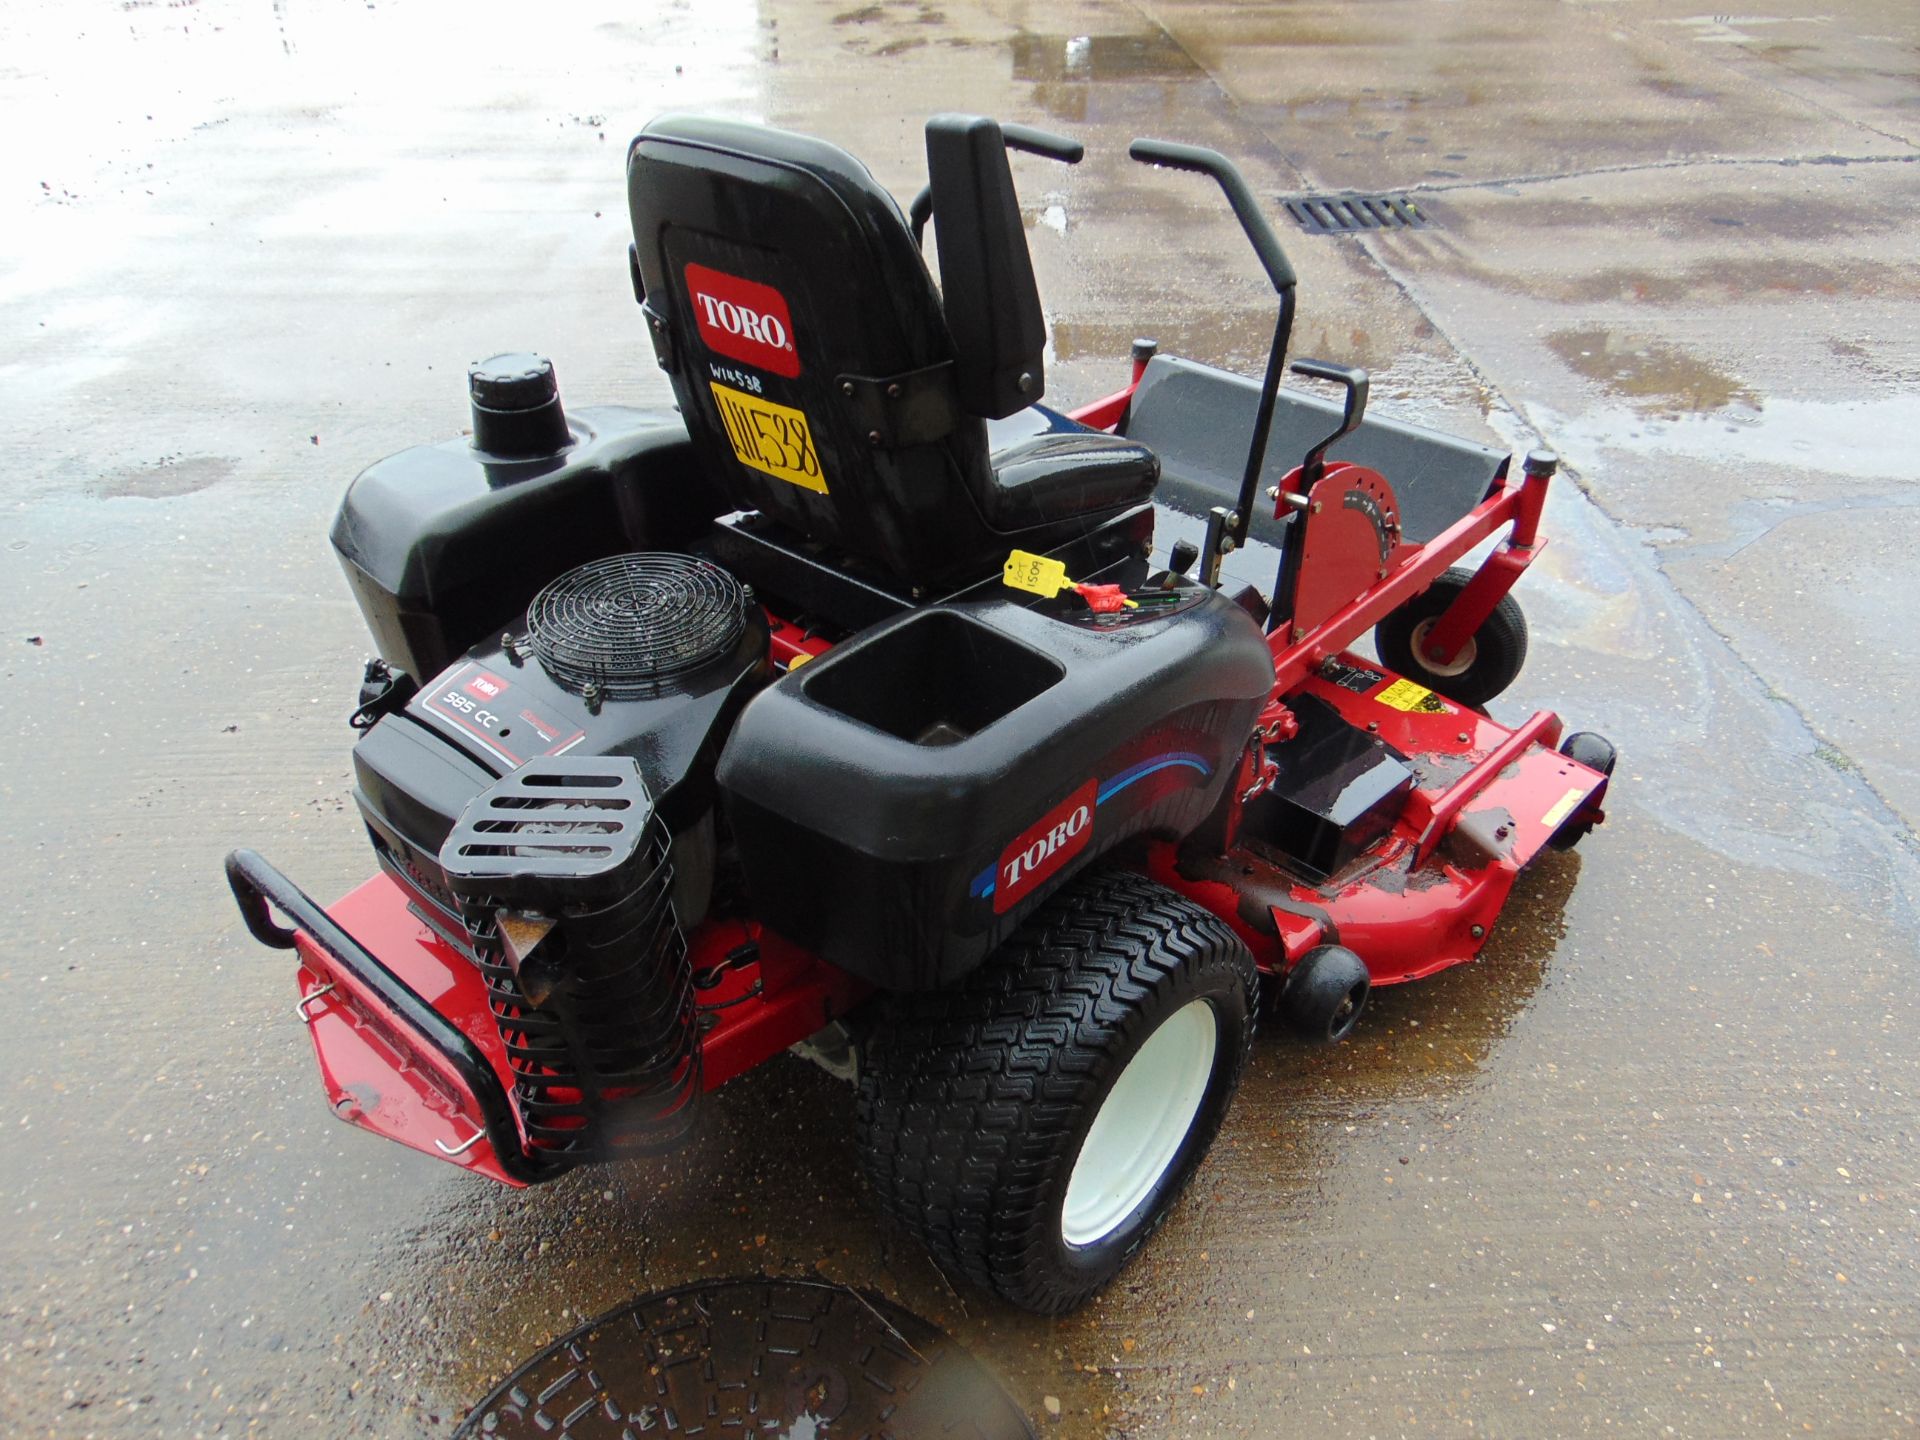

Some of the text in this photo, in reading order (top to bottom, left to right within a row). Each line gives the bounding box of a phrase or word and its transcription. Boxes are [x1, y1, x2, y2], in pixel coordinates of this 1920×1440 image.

[697, 292, 787, 350] TORO
[709, 362, 762, 393] W14538
[472, 677, 500, 697] TORO
[474, 709, 499, 729] CC
[1003, 804, 1089, 889] TORO
